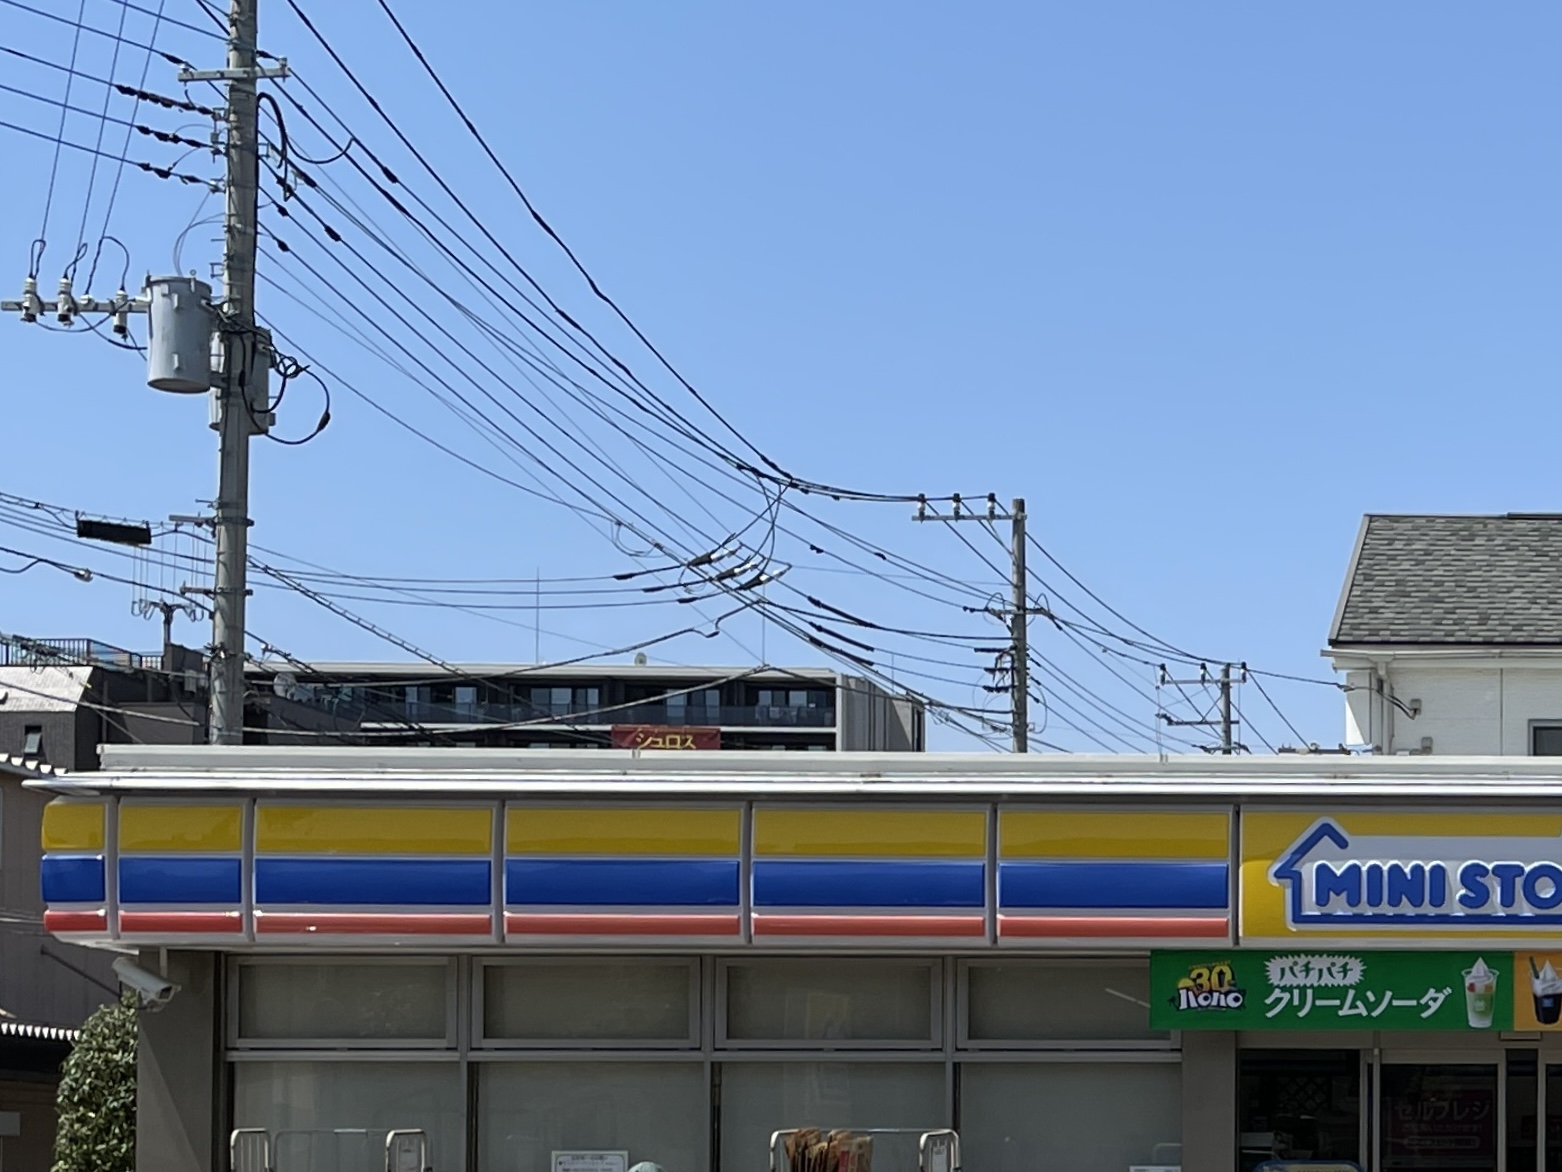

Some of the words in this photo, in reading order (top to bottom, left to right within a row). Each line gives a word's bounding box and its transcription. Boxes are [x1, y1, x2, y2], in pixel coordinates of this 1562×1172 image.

[635, 733, 696, 750] シュロス
[1313, 862, 1447, 908] MINI
[1190, 965, 1233, 993] 30
[1280, 960, 1354, 982] パチパチ
[1264, 986, 1453, 1018] クリームソーダ
